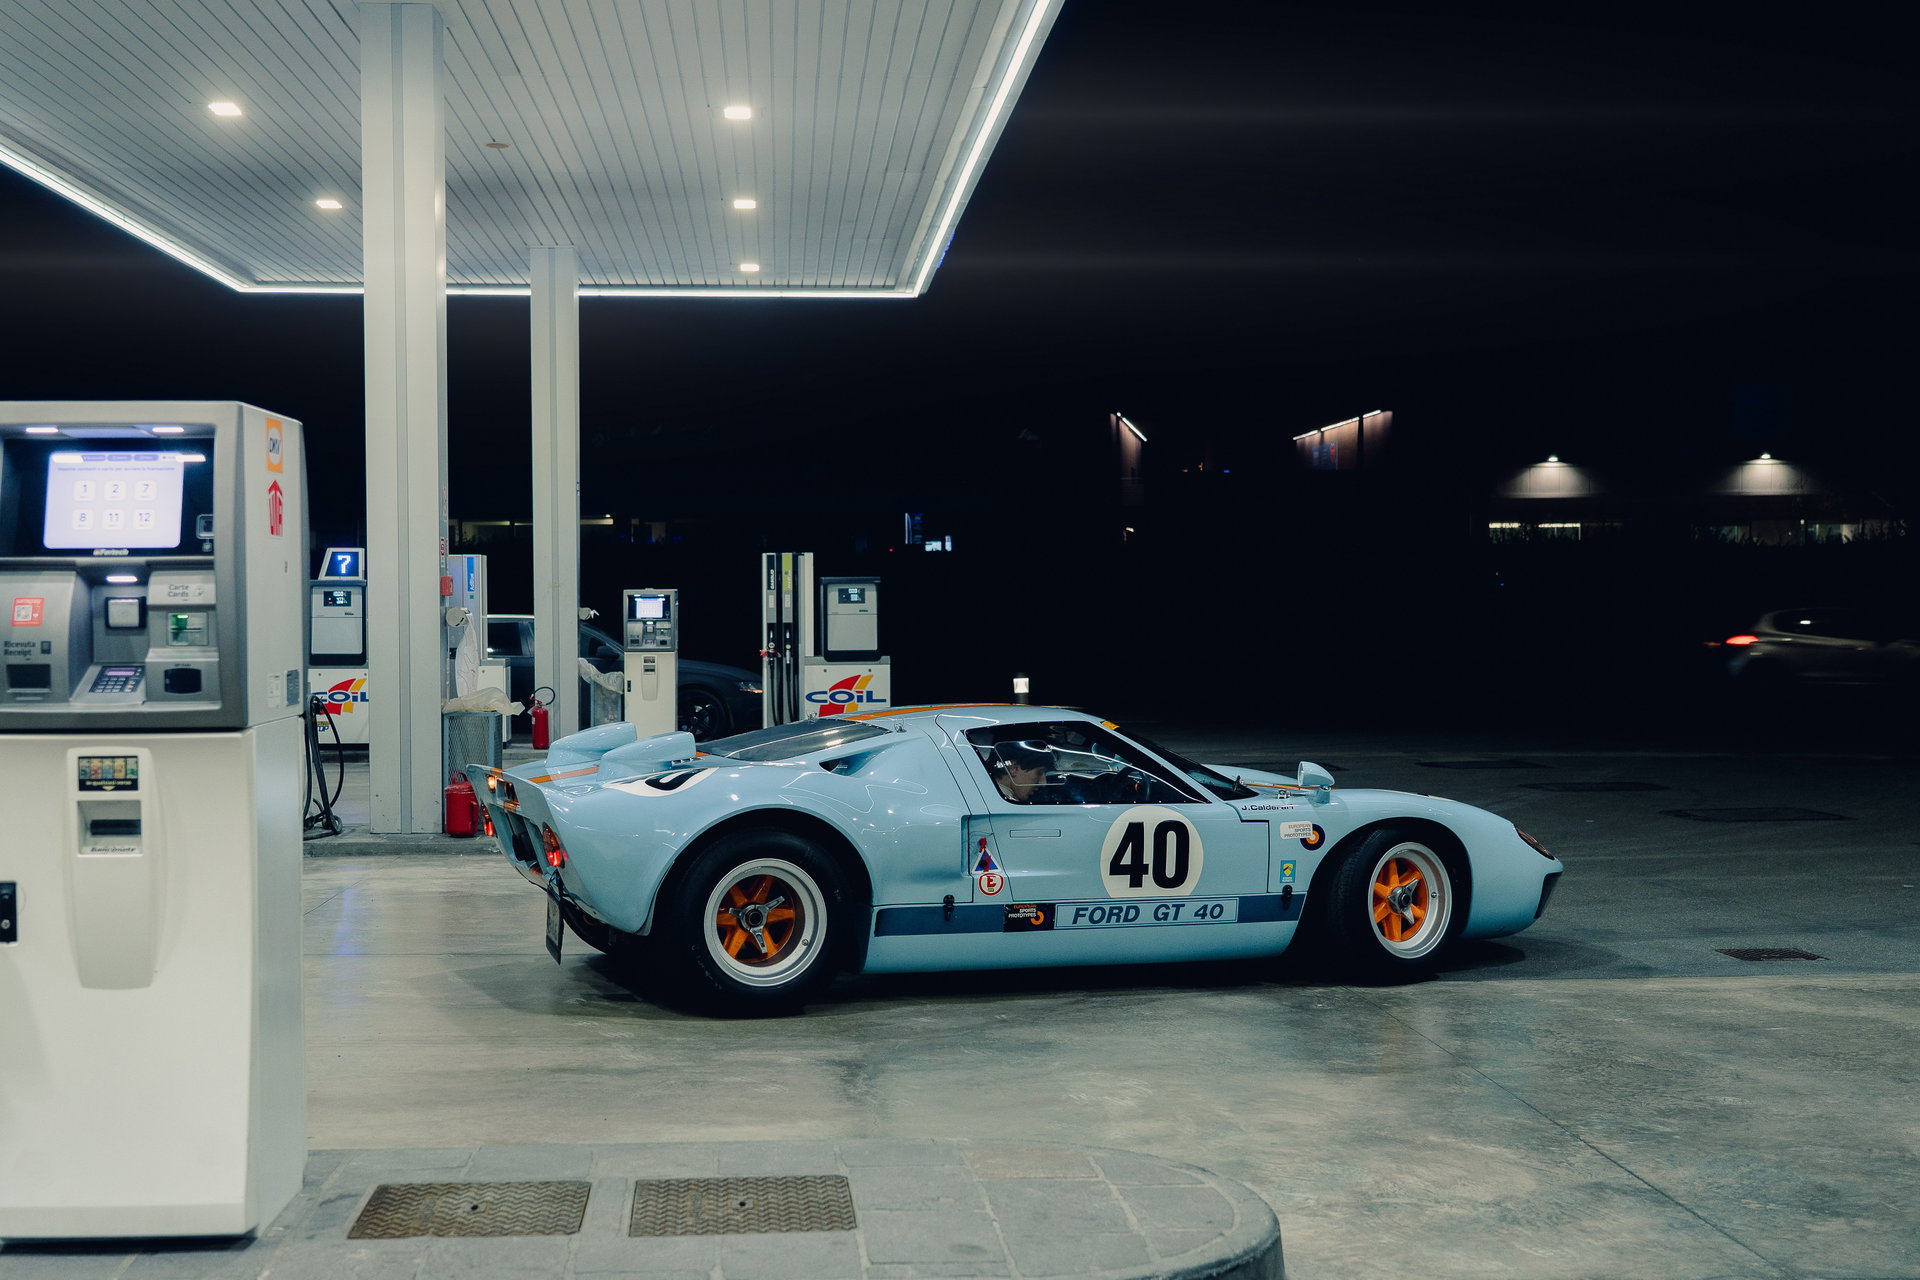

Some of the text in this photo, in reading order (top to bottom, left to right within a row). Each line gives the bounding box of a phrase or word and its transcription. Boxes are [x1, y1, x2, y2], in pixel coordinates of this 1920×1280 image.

[112, 484, 120, 493] 2
[143, 484, 150, 493] 7
[79, 513, 87, 522] 8
[138, 513, 151, 522] 12
[337, 555, 351, 574] 7
[1109, 820, 1190, 889] 40
[986, 875, 997, 888] E
[1072, 903, 1224, 925] FORD GT 40
